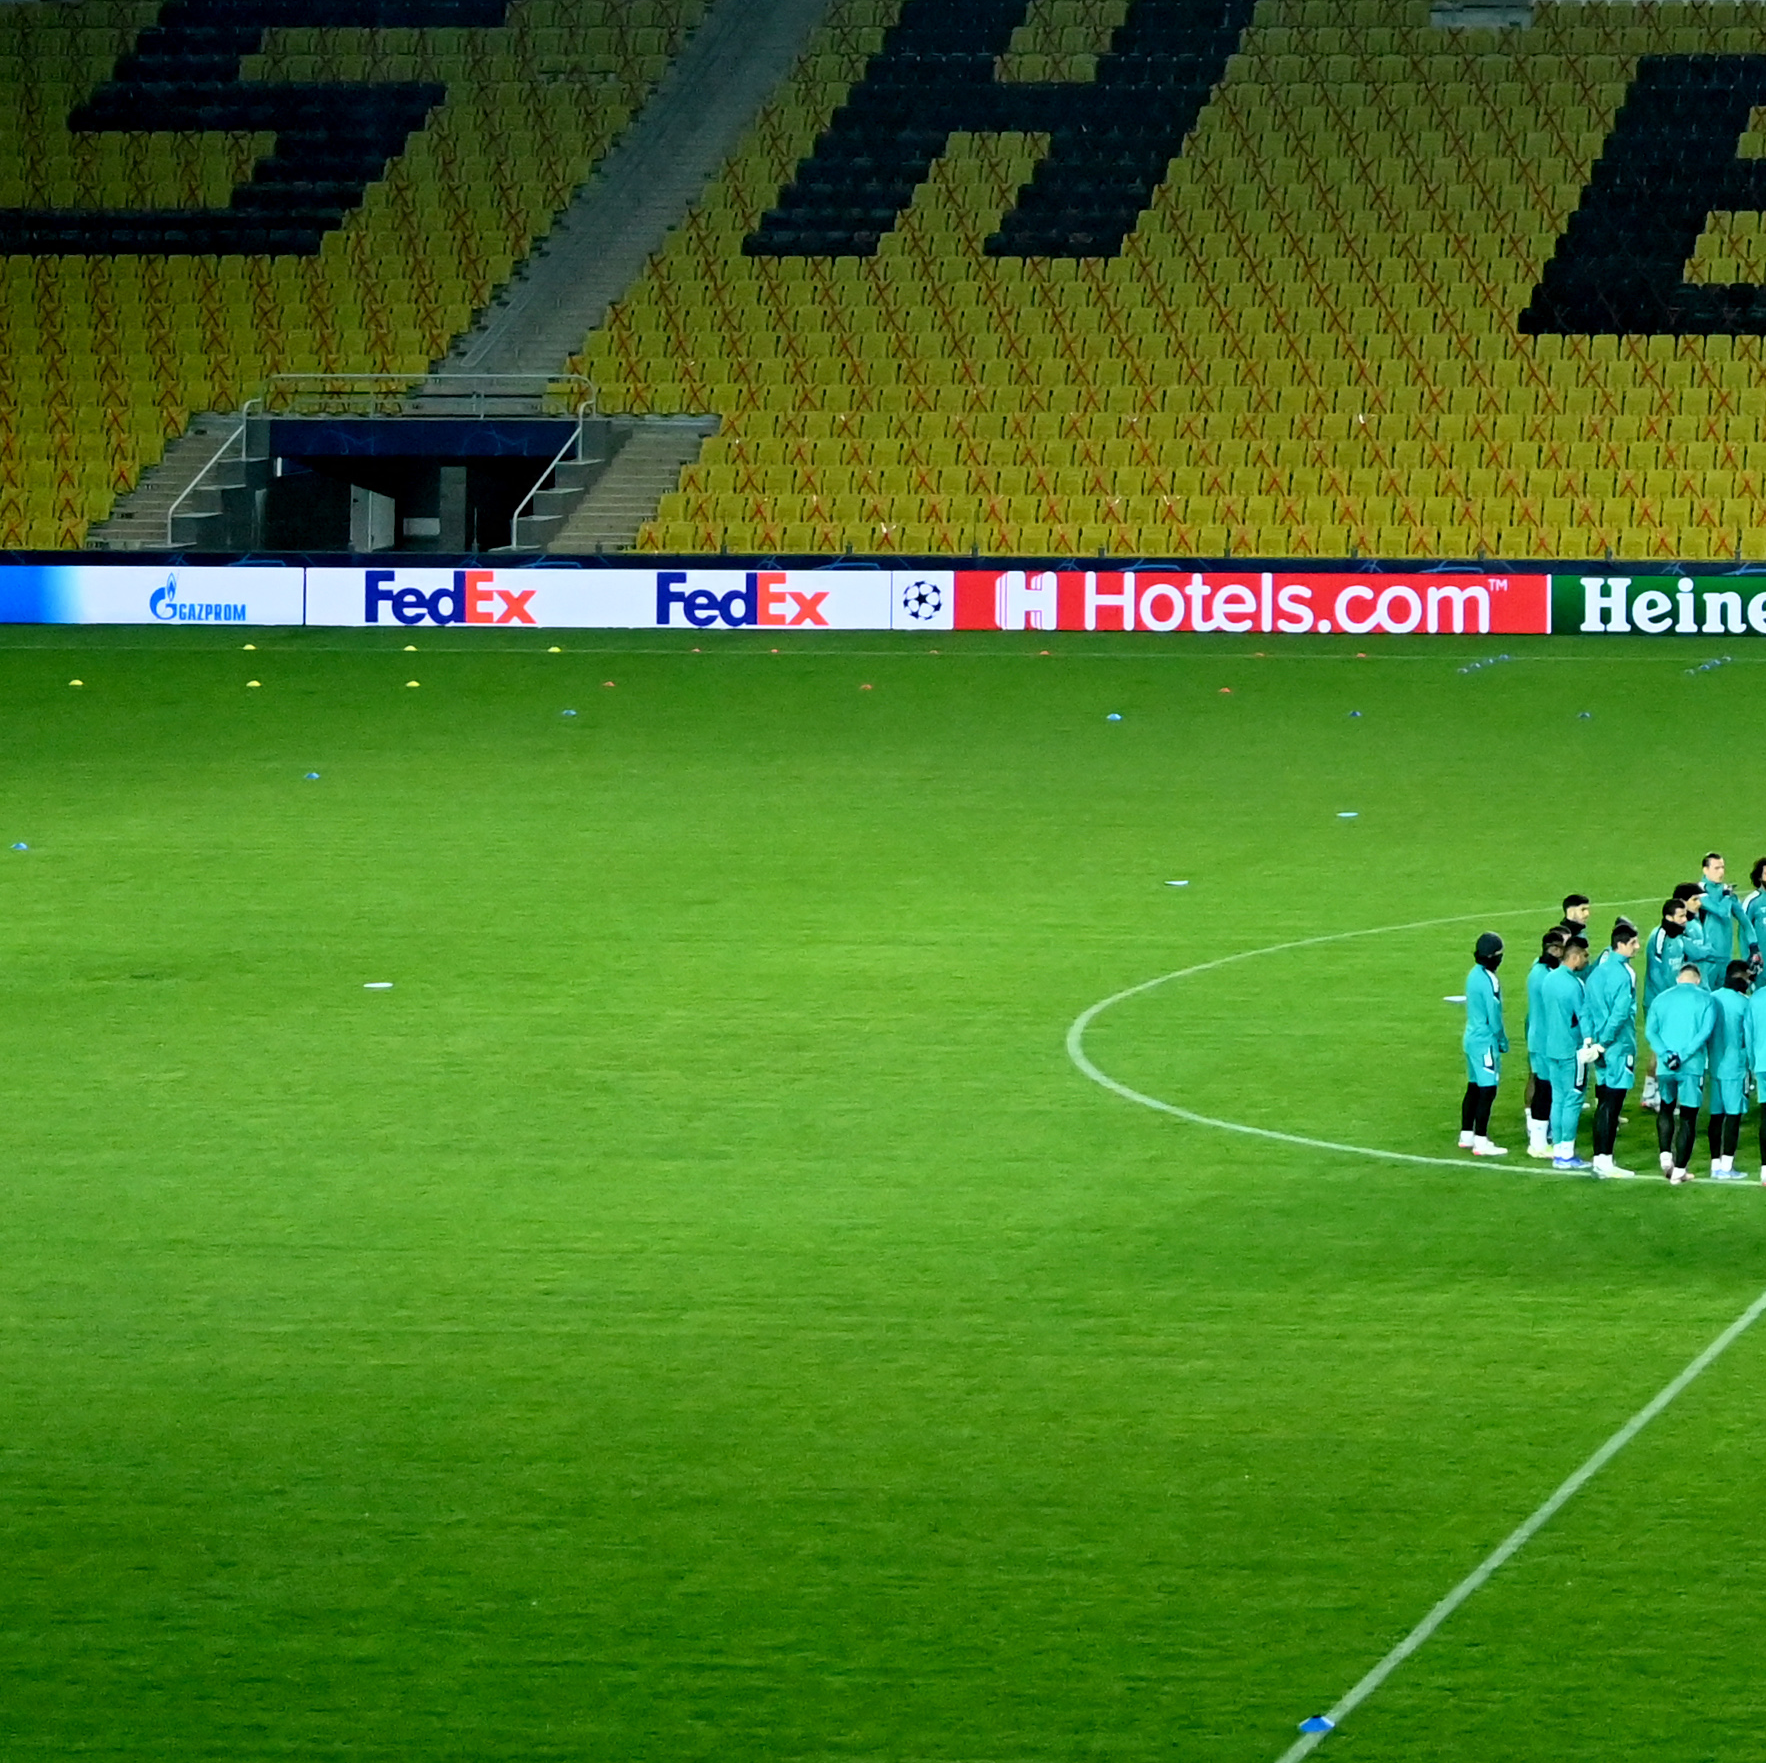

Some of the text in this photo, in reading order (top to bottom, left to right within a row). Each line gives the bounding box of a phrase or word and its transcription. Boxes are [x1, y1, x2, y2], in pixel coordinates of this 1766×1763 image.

[178, 603, 247, 622] GAZPROM
[364, 570, 538, 625] FedEx
[656, 572, 830, 627] FedEx
